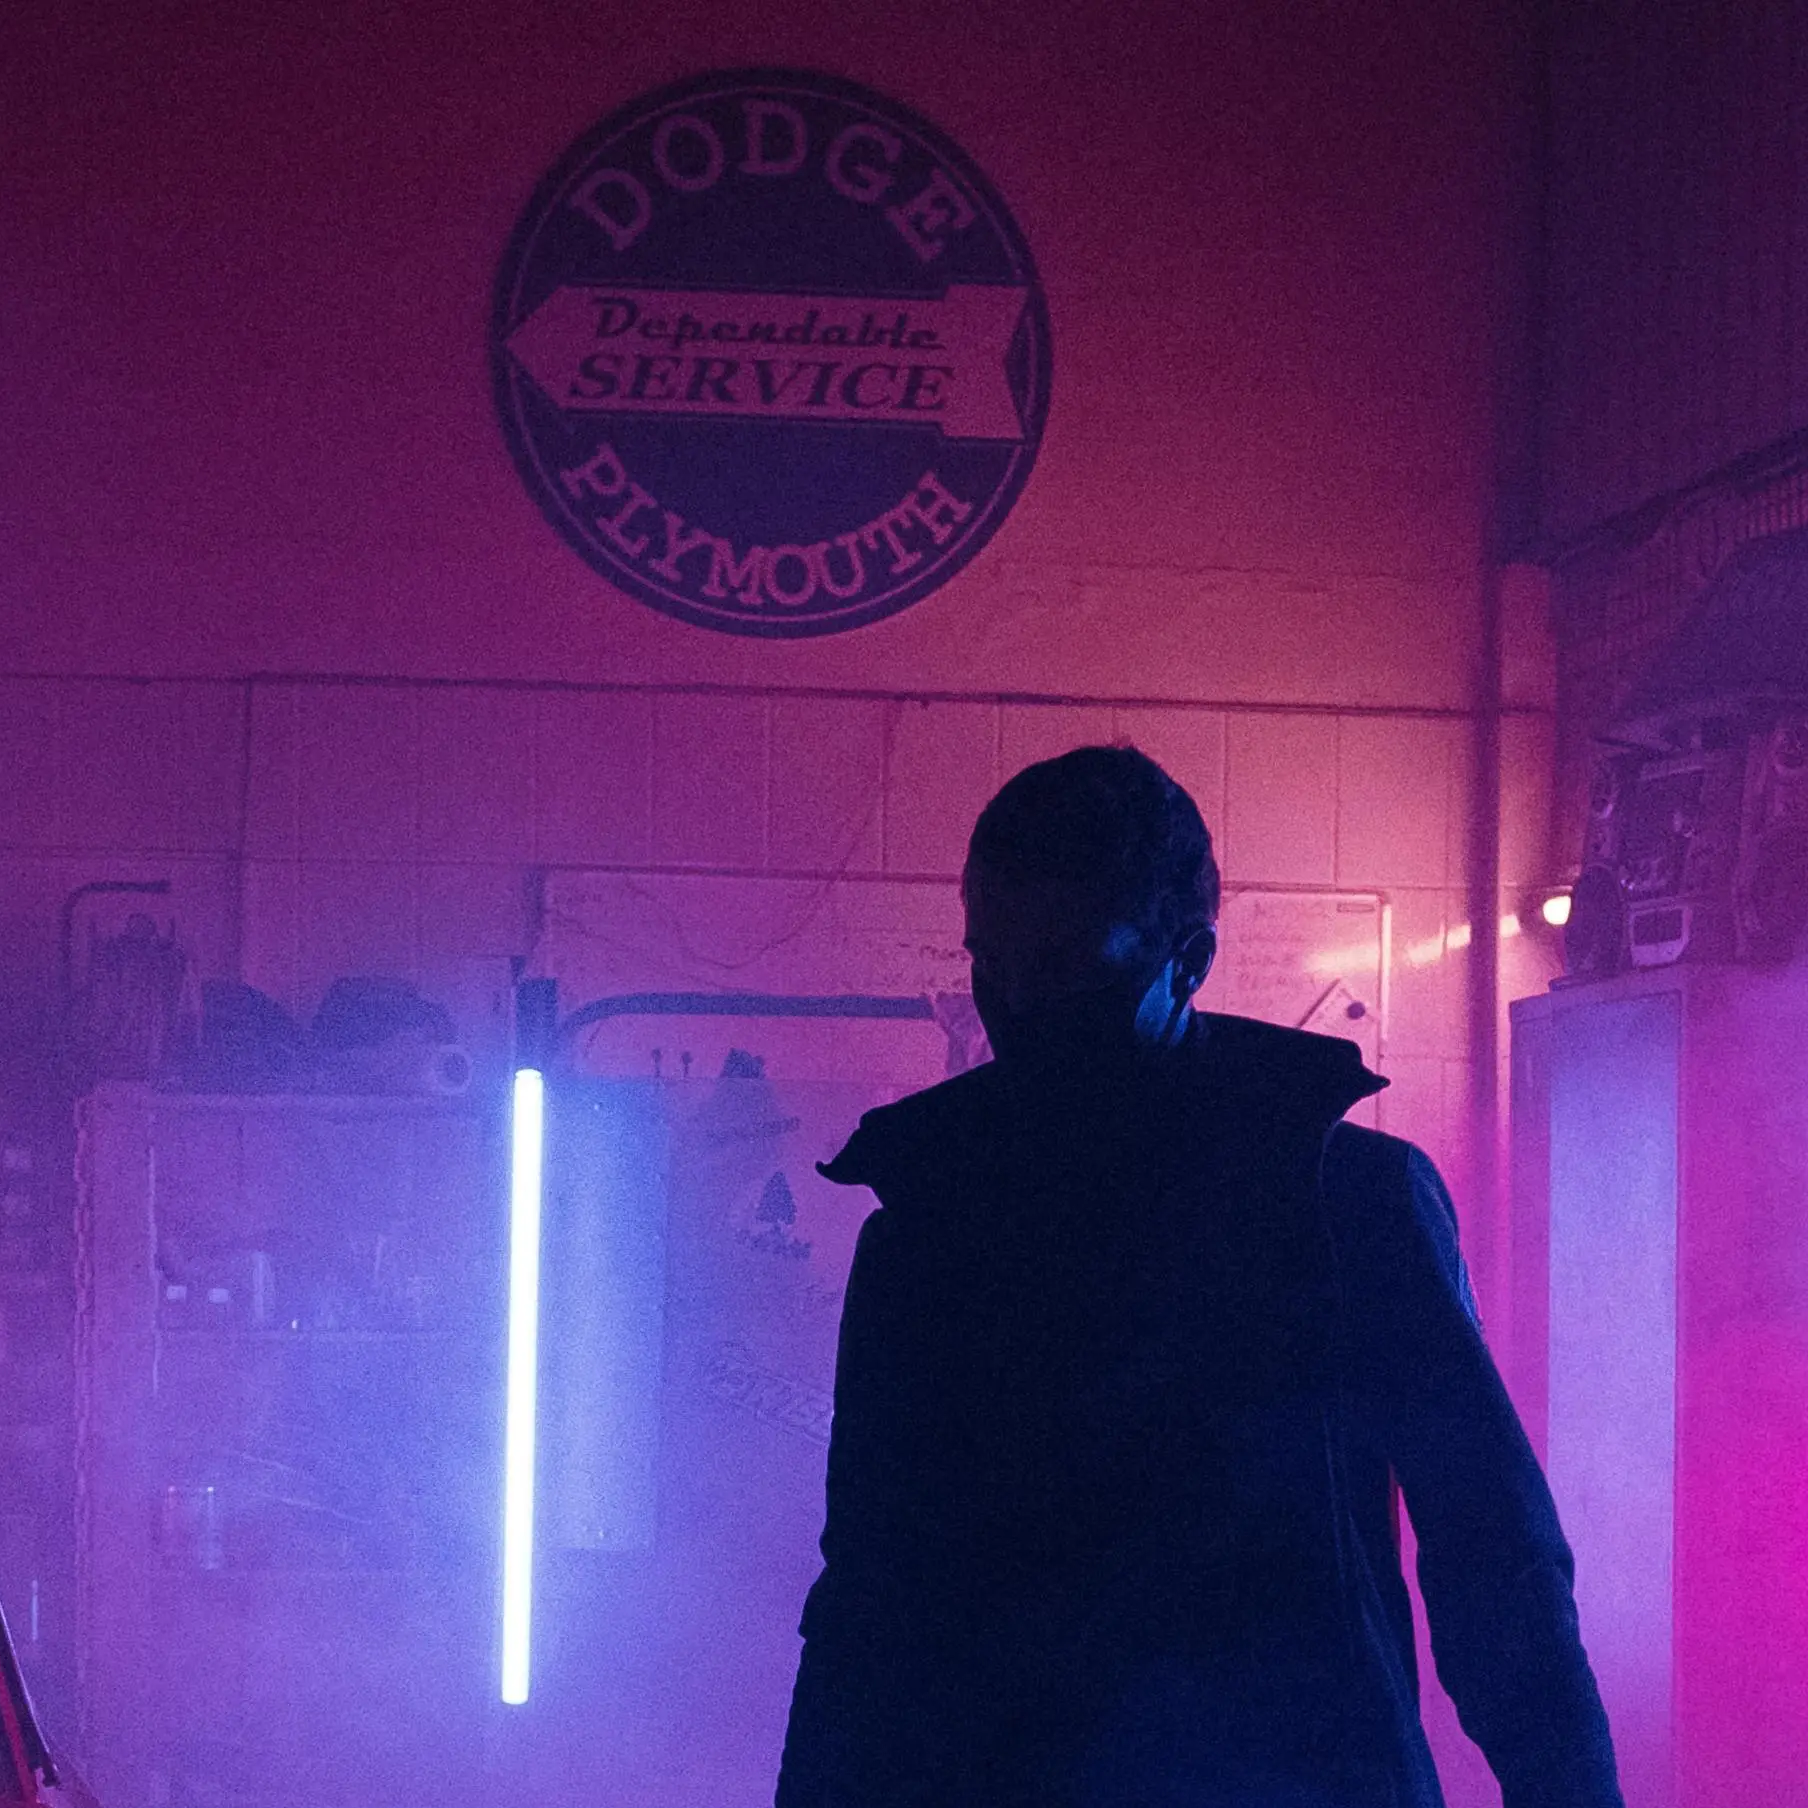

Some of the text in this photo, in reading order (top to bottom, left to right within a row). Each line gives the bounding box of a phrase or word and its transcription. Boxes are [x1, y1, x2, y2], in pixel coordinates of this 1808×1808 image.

[571, 99, 976, 264] DODGE
[594, 298, 948, 352] Dependable
[568, 353, 956, 411] SERVICE
[561, 442, 974, 605] PLYMOUTH
